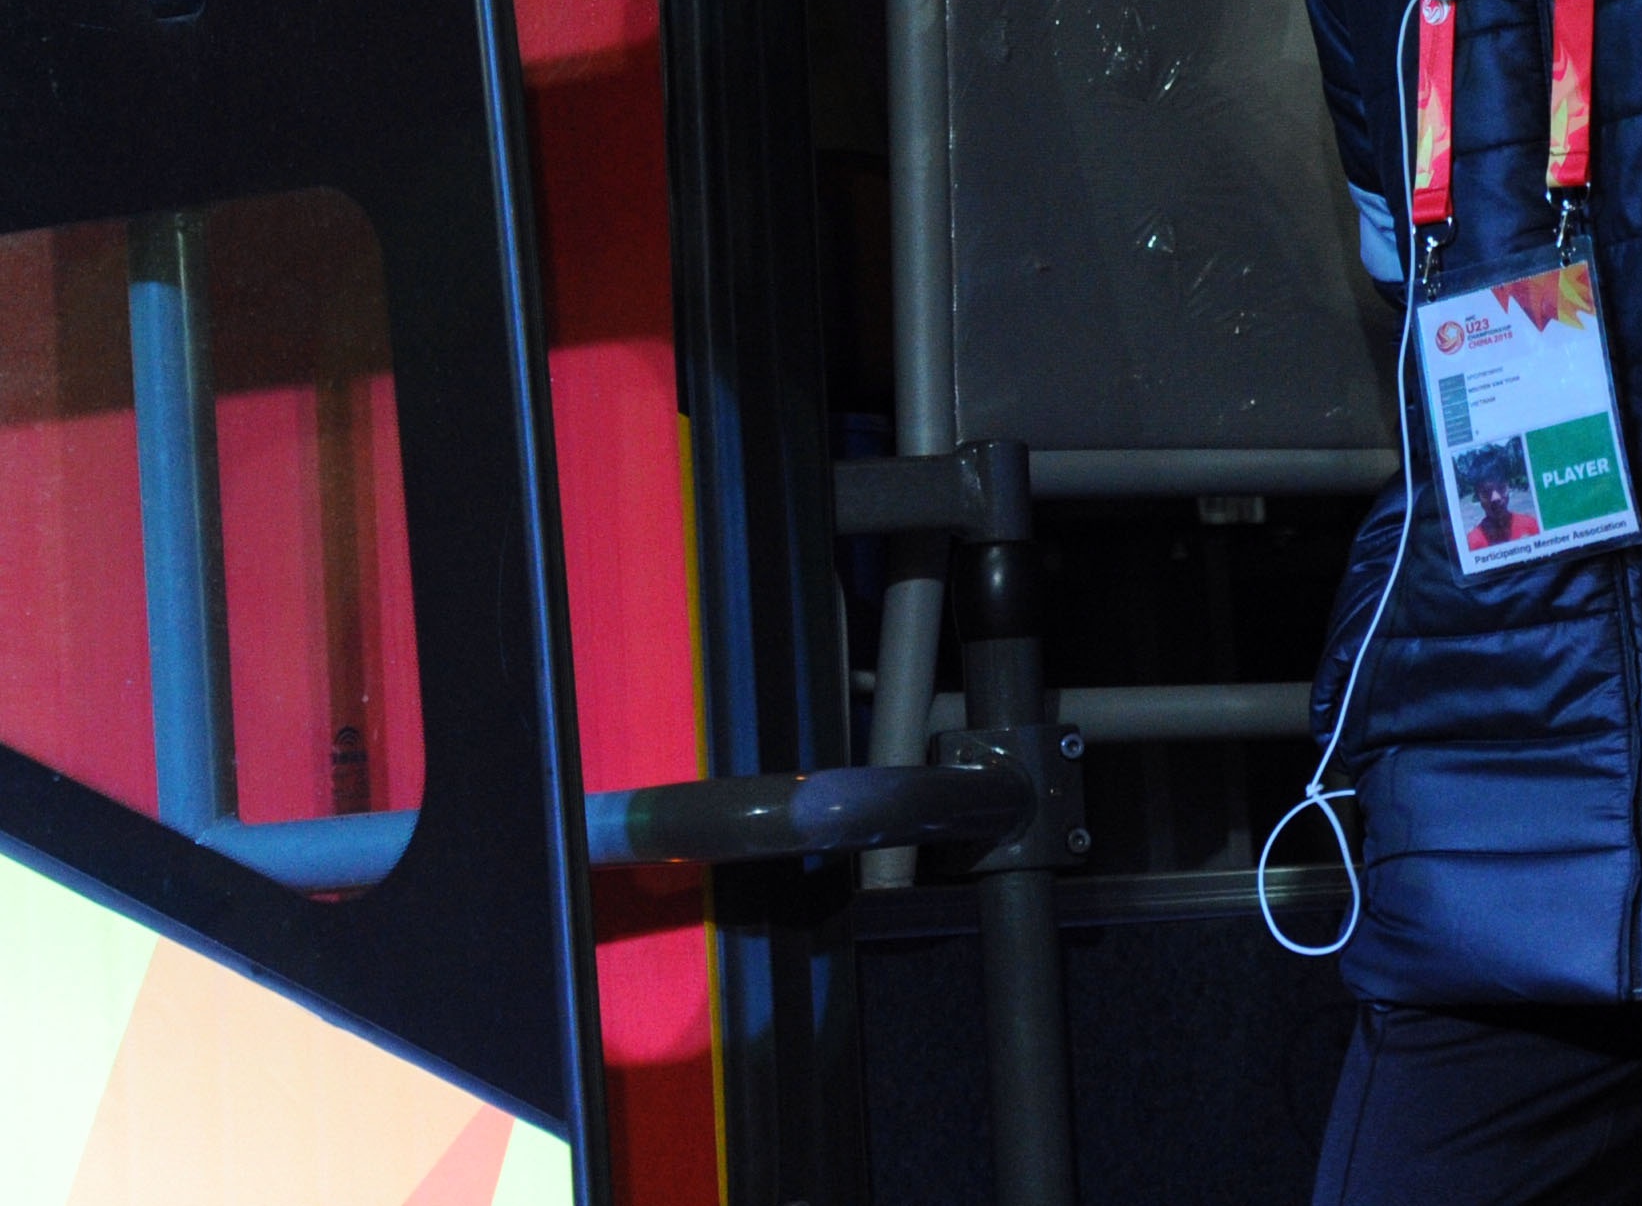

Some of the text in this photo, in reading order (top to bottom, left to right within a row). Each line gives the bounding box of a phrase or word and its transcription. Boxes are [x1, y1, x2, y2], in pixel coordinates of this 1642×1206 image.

[1466, 317, 1490, 334] U23
[1542, 457, 1611, 489] PLAYER
[1474, 519, 1628, 565] Participating Member Association
